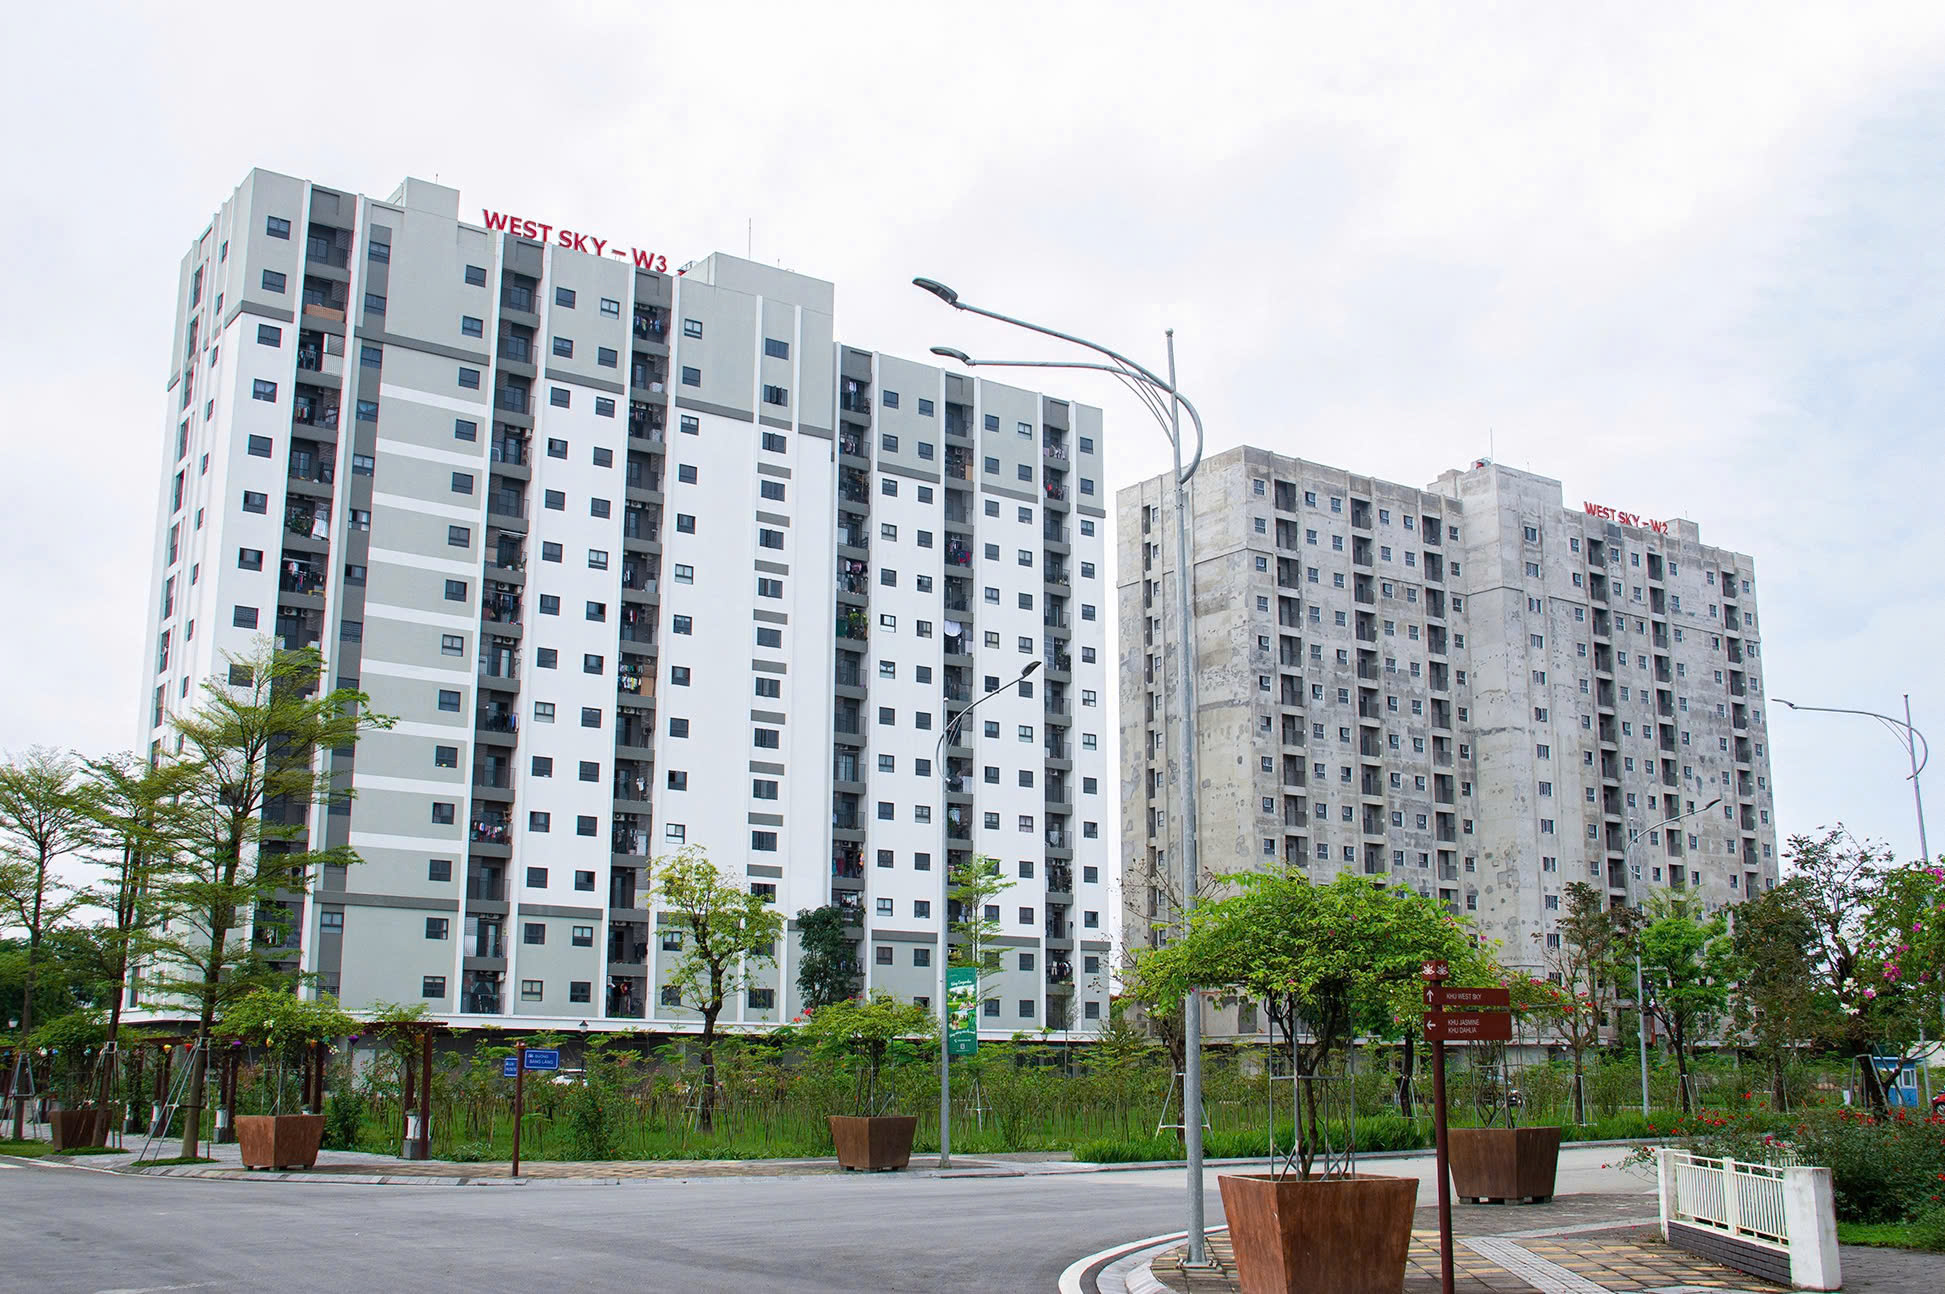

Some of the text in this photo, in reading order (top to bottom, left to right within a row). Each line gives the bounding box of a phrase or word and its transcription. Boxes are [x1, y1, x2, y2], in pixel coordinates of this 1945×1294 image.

[482, 208, 553, 243] WEST
[558, 229, 608, 257] SKY
[631, 247, 668, 273] W3
[1584, 501, 1617, 521] WEST
[1617, 511, 1641, 528] SKY
[1649, 519, 1669, 535] W2
[1446, 992, 1458, 1000] KHU
[1458, 992, 1472, 1000] WEST
[1459, 1018, 1480, 1026] JASMINE
[1447, 1026, 1477, 1034] KHU DAHLIA
